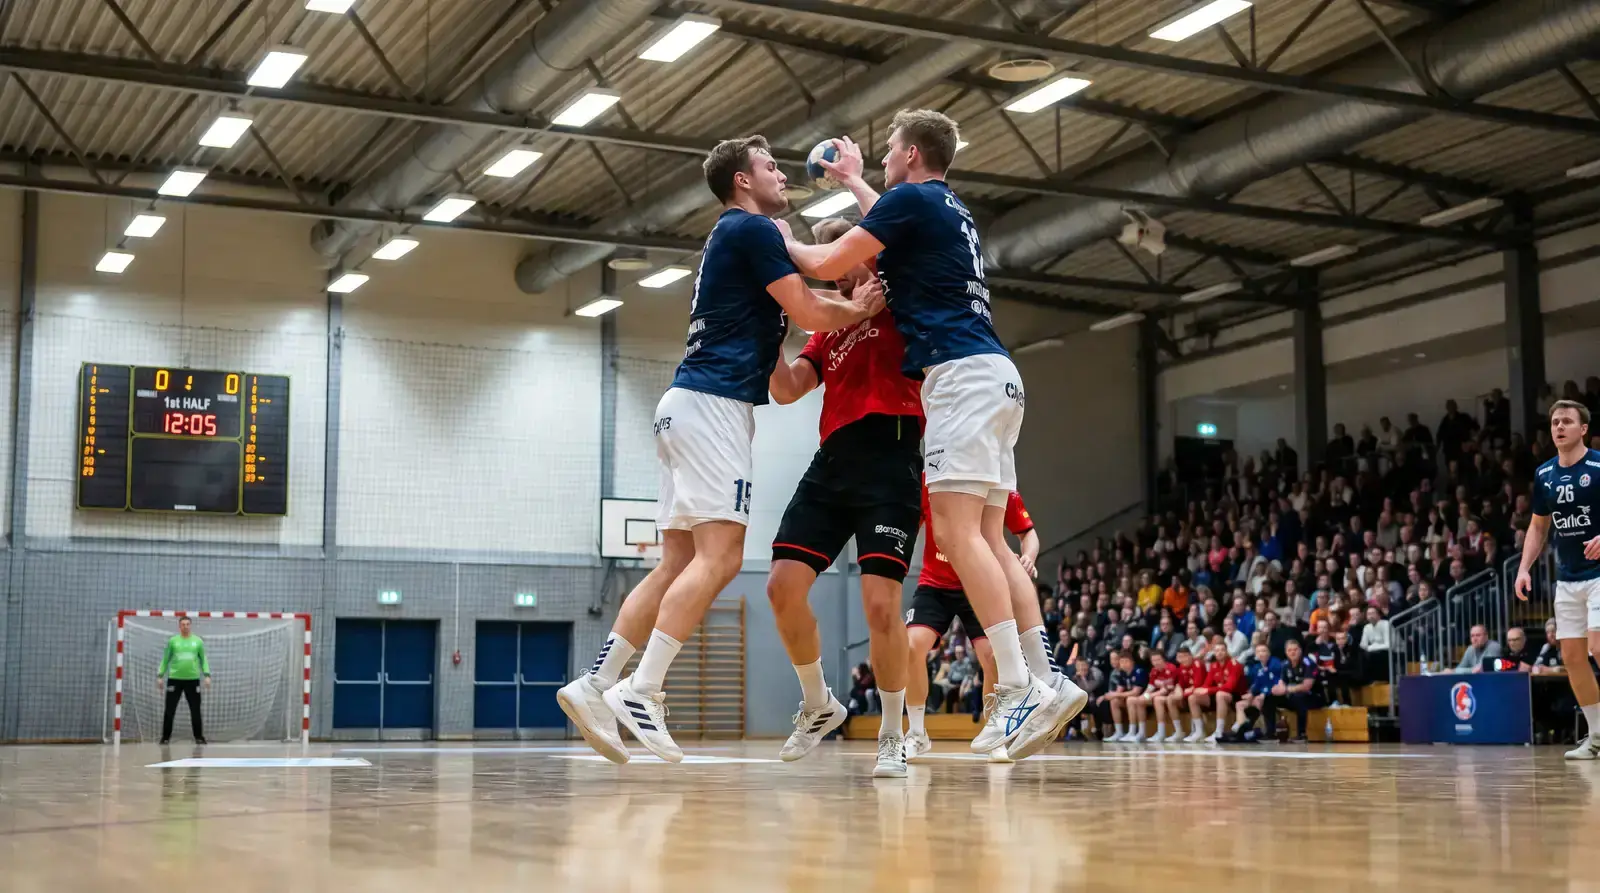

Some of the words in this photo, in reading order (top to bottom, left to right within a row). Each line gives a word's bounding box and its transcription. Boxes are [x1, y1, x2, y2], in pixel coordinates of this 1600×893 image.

[155, 370, 169, 390] 0
[225, 374, 239, 394] 0
[164, 396, 180, 408] 1st
[182, 397, 211, 410] HALF
[165, 413, 216, 435] 12:05
[733, 478, 752, 515] 15
[1556, 484, 1574, 504] 26
